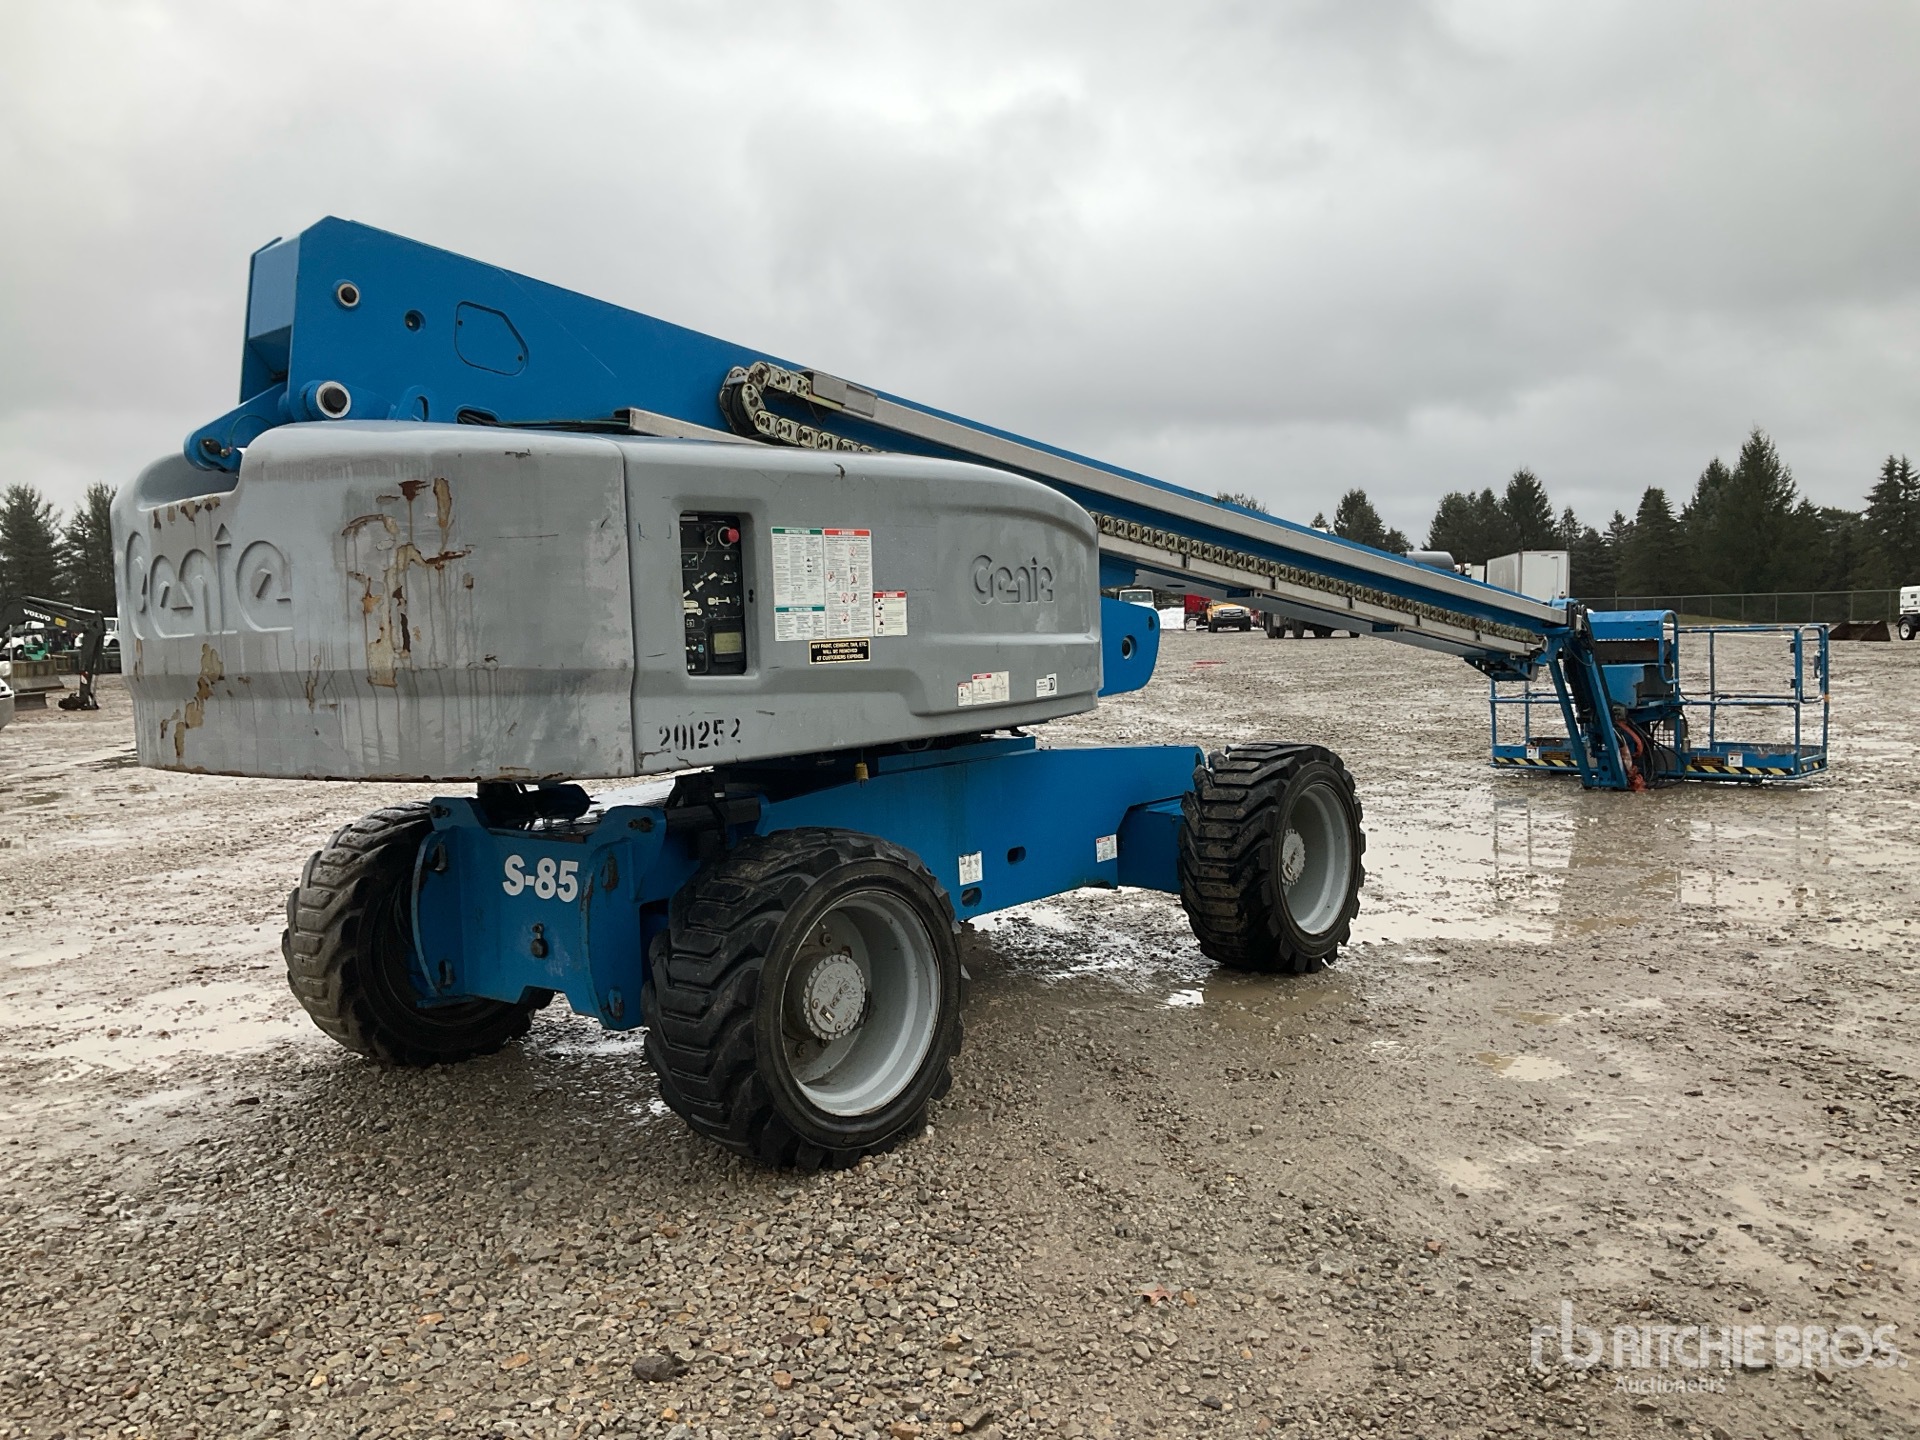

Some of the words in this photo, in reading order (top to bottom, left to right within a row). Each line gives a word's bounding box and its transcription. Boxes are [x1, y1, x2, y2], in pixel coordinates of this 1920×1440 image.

[970, 554, 1055, 605] Genie
[23, 608, 51, 622] VOLVO
[502, 854, 579, 903] S-85
